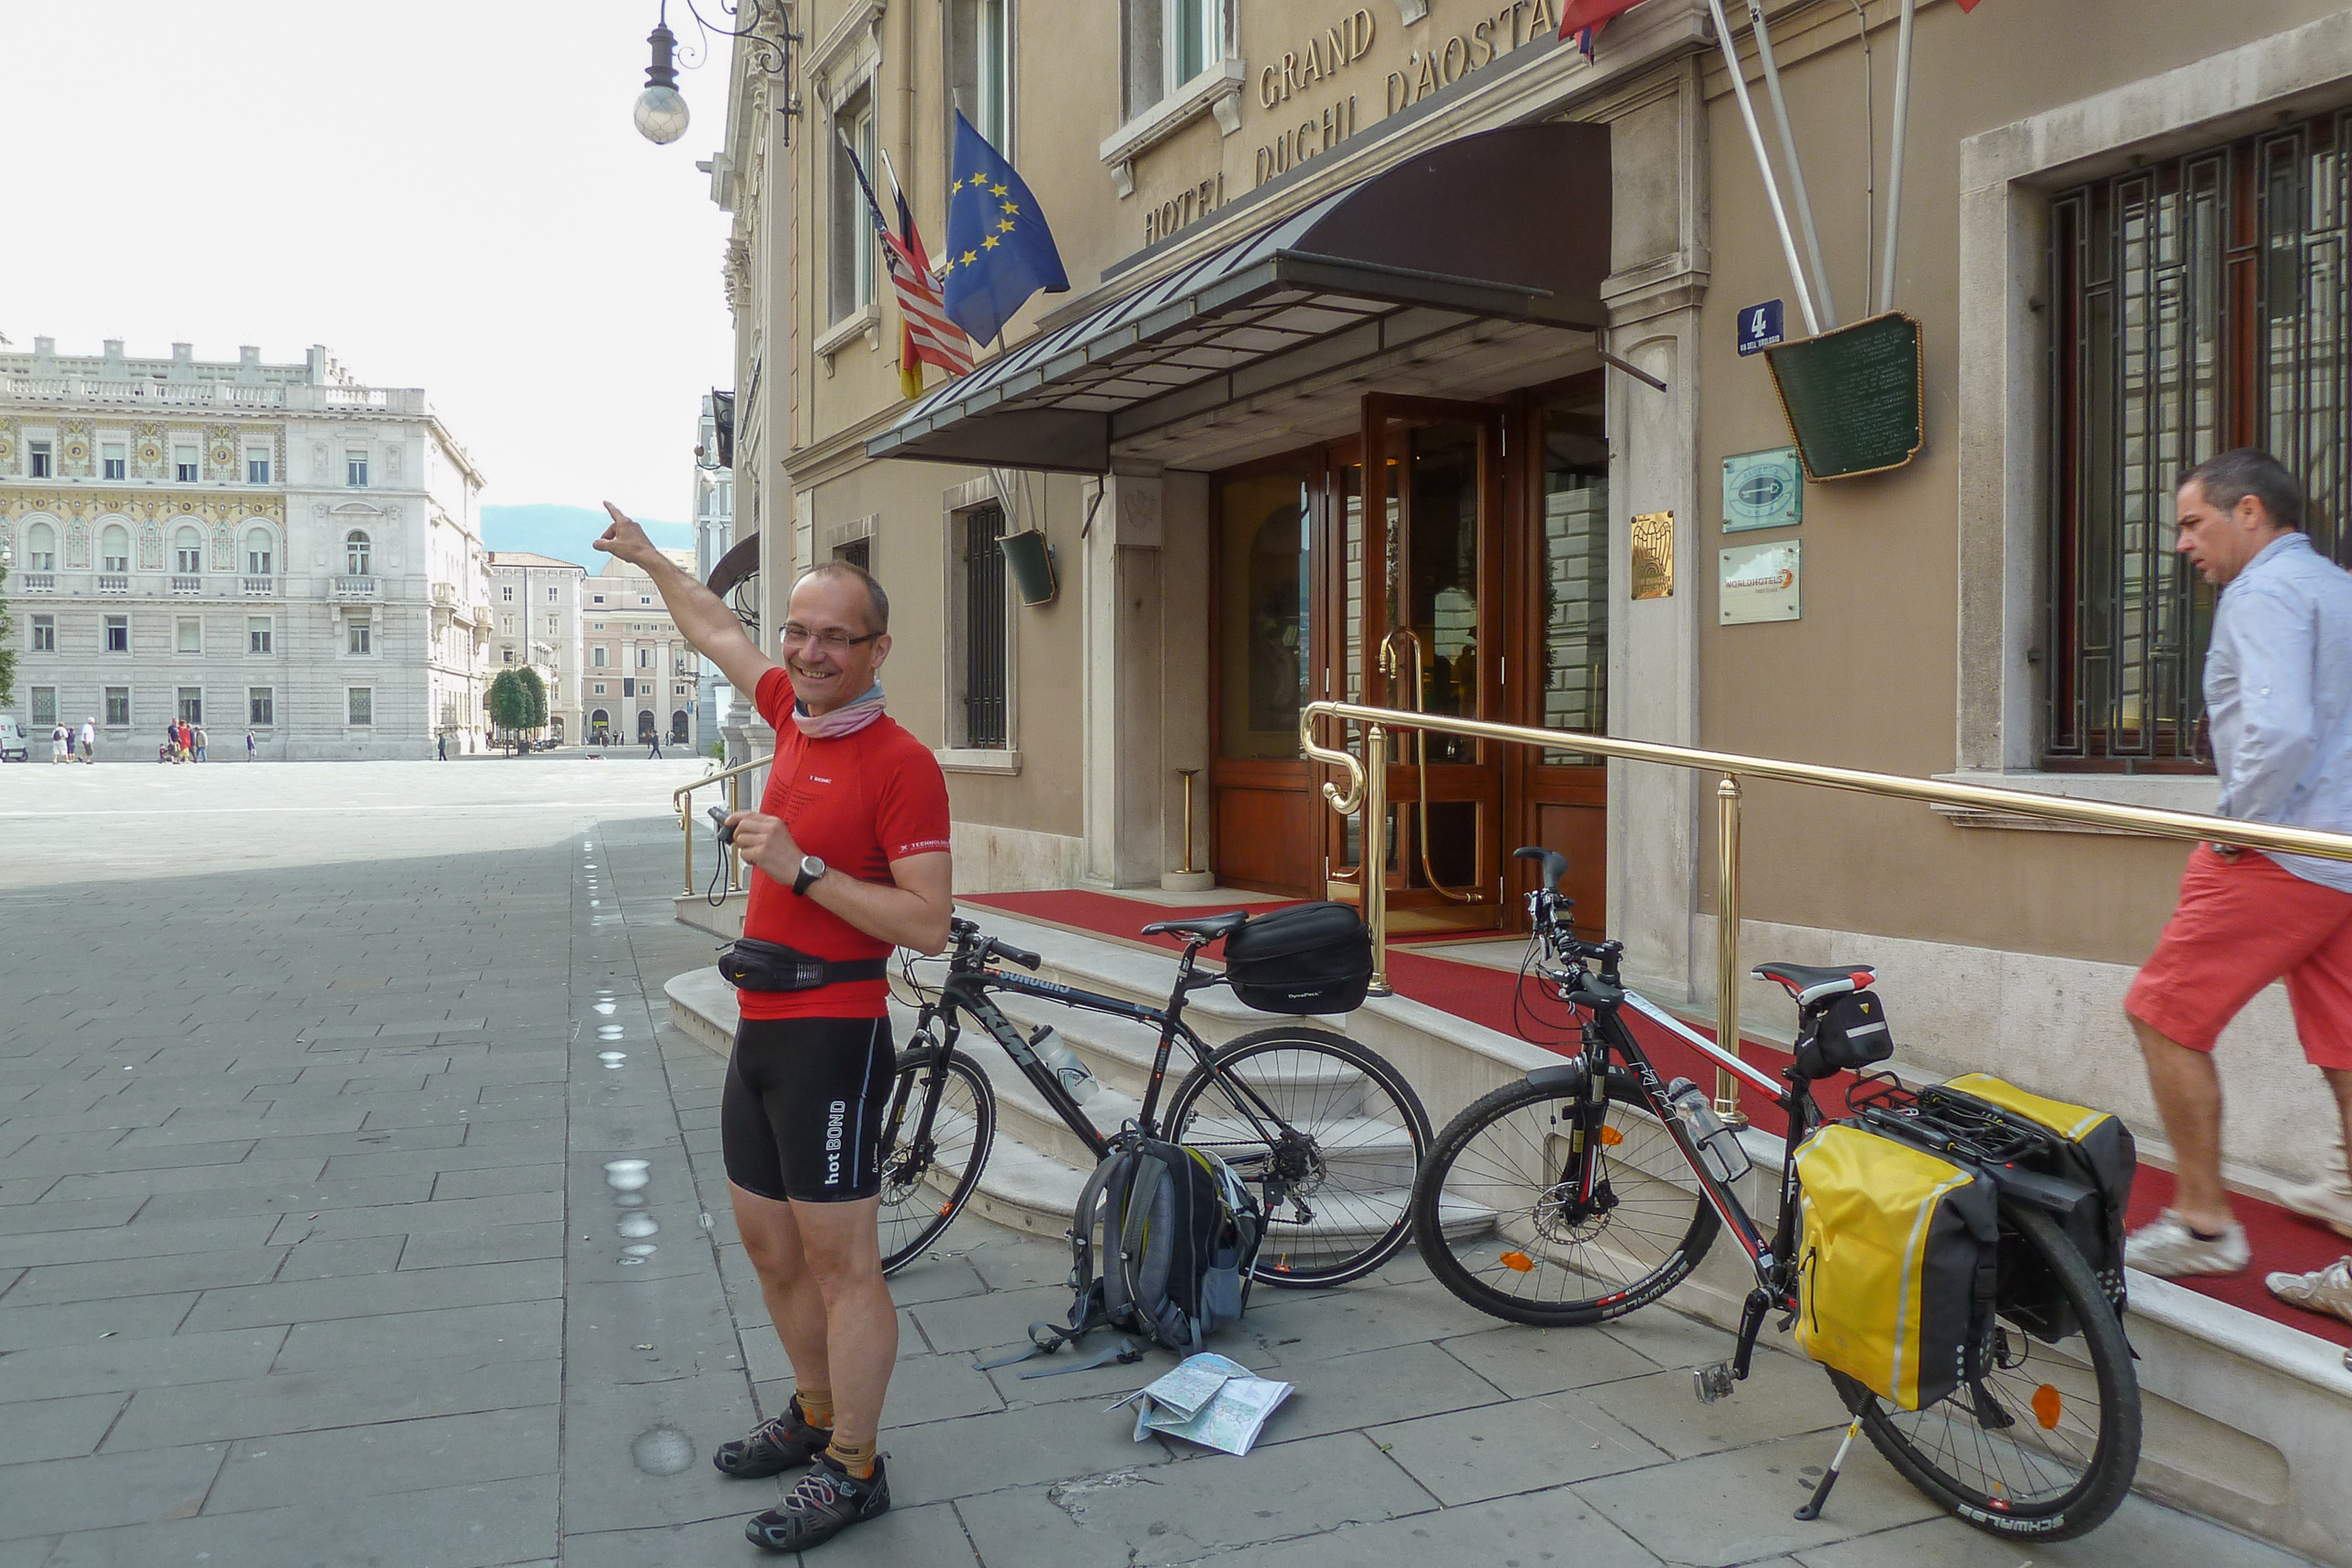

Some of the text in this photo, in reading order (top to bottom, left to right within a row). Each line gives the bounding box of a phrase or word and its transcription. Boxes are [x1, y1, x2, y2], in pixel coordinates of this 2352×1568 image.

[1259, 8, 1374, 109] GRAND
[1145, 172, 1231, 249] HOTEL
[1255, 93, 1356, 188] DUCHI
[1751, 308, 1767, 339] 4
[1725, 575, 1782, 589] WORLDHOTELS
[975, 1005, 1037, 1066] KTM
[825, 1100, 846, 1185] hot BOND
[1601, 1260, 1690, 1318] SCHWALBE
[1957, 1503, 2065, 1533] SCHWALBE
